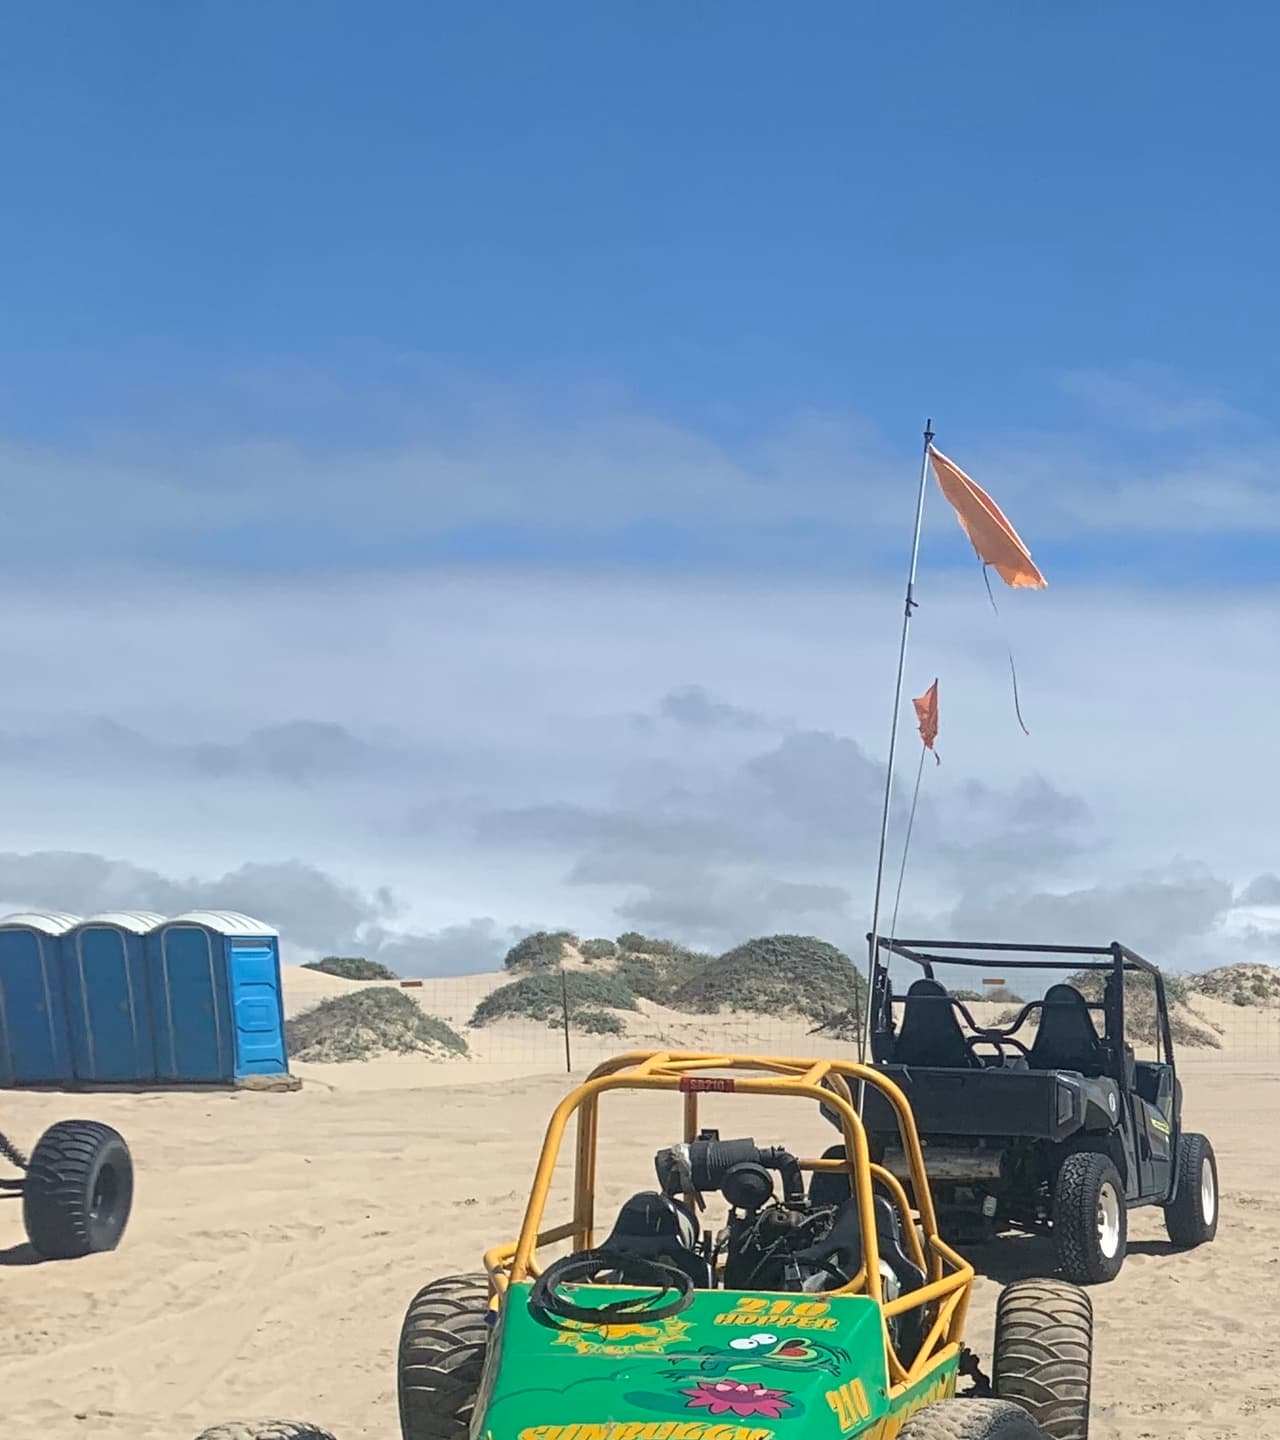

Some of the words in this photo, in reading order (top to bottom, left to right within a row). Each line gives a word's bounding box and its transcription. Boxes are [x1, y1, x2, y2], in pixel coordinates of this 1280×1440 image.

[729, 1297, 831, 1316] 210
[713, 1313, 840, 1332] HOPPER
[825, 1378, 871, 1434] 210
